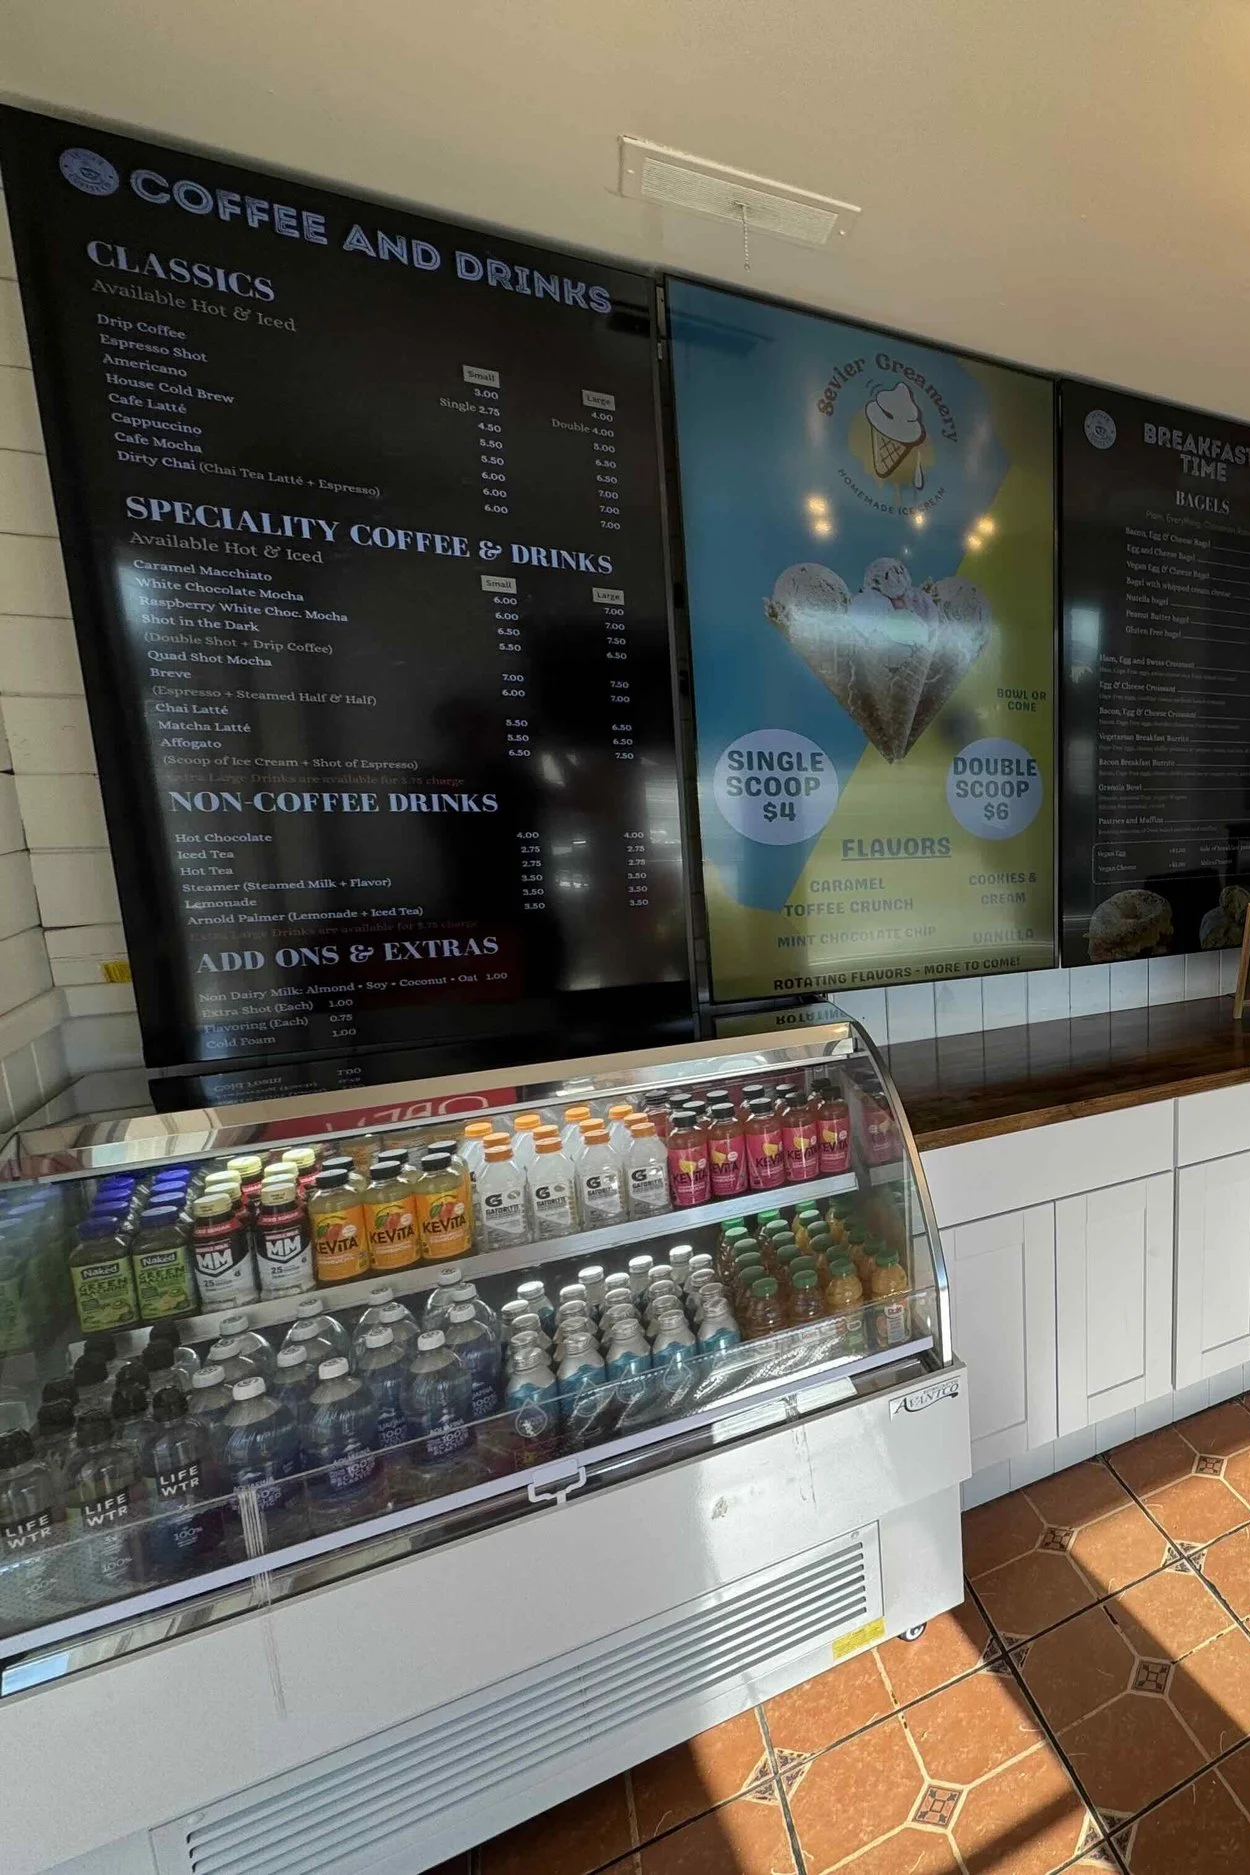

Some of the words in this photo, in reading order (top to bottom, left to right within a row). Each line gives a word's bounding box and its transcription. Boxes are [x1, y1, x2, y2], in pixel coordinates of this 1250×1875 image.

[130, 169, 328, 245] COFFEE
[343, 224, 441, 271] AND
[455, 250, 612, 314] DRINKS
[87, 240, 275, 301] CLASSICS
[92, 280, 186, 309] Available
[190, 298, 226, 320] Hot
[233, 306, 252, 321] &
[257, 312, 296, 332] Iced
[96, 314, 133, 331] Drip
[138, 322, 187, 340] Coffee
[100, 334, 170, 356] Espresso
[174, 347, 208, 362] Shot
[103, 354, 188, 377] Americano
[467, 370, 496, 382] Small
[106, 373, 154, 390] House
[159, 382, 192, 398] Cold
[198, 389, 235, 404] Brew
[474, 388, 498, 400] 3.00
[817, 357, 866, 417] Sevier
[108, 392, 142, 408] Cafe
[148, 398, 187, 414] Latté
[440, 398, 477, 412] Single
[478, 406, 500, 416] 2.75
[112, 412, 202, 434] Cappuccino
[478, 422, 502, 433] 4.50
[552, 418, 590, 433] Double
[592, 427, 614, 438] 4.00
[114, 432, 148, 446] Cafe
[153, 437, 202, 453] Mocha
[118, 450, 158, 467] Dirty
[162, 457, 197, 470] Chai
[200, 461, 236, 478] (Chai
[240, 468, 264, 480] Tea
[268, 471, 303, 486] Latté
[318, 480, 380, 498] Espresso)
[1180, 453, 1228, 482] TIME
[483, 488, 507, 498] 6.00
[838, 468, 894, 515] HOMEMADE
[898, 508, 914, 516] ICE
[1176, 489, 1230, 514] BAGELS
[126, 496, 340, 542] SPECIALITY
[350, 524, 470, 558] COFFEE
[479, 540, 502, 560] &
[511, 544, 613, 574] DRINKS
[600, 520, 620, 530] 7.00
[130, 532, 219, 552] Available
[224, 542, 258, 558] Hot
[264, 545, 280, 558] &
[287, 548, 324, 564] Iced
[134, 559, 196, 574] Caramel
[200, 565, 272, 582] Macchiato
[135, 577, 182, 591] White
[186, 582, 256, 598] Chocolate
[260, 588, 304, 601] Mocha
[486, 580, 512, 590] Small
[596, 592, 620, 602] Large
[140, 596, 215, 612] Raspberry
[219, 602, 262, 614] White
[265, 606, 302, 618] Choc.
[306, 610, 348, 622] Mocha
[142, 614, 175, 626] Shot
[179, 616, 194, 627] in
[197, 618, 220, 629] the
[224, 620, 260, 632] Dark
[148, 650, 186, 662] Quad
[190, 652, 224, 664] Shot
[227, 655, 272, 668] Mocha
[150, 667, 192, 679] Breve
[997, 688, 1028, 700] BOWL
[1031, 690, 1048, 702] OR
[156, 702, 188, 714] Chai
[192, 703, 229, 716] Latté
[1007, 701, 1037, 712] CONE
[158, 720, 212, 732] Matcha
[215, 720, 252, 733] Latté
[160, 737, 222, 750] Affogato
[727, 750, 824, 773] SINGLE
[953, 756, 1038, 777] DOUBLE
[726, 775, 821, 798] SCOOP
[956, 780, 1030, 799] SCOOP
[168, 791, 380, 813] NON-COFFEE
[388, 792, 498, 813] DRINKS
[763, 802, 796, 822] $4
[984, 802, 1010, 822] $6
[175, 834, 202, 843] Hot
[204, 832, 272, 844] Chocolate
[842, 837, 952, 858] FLAVORS
[178, 850, 207, 860] Iced
[210, 849, 234, 860] Tea
[180, 866, 206, 876] Hot
[208, 866, 234, 876] Tea
[968, 872, 1026, 886] COOKIES
[1028, 872, 1038, 883] &
[182, 882, 240, 892] Steamer
[243, 880, 304, 893] (Steamed
[308, 879, 336, 890] Milk
[350, 877, 392, 890] Flavor)
[810, 877, 886, 894] CARAMEL
[185, 898, 258, 910] Lemonade
[784, 902, 844, 918] TOFFEE
[850, 898, 914, 913] CRUNCH
[980, 892, 1026, 906] CREAM
[778, 934, 816, 949] MINT
[820, 929, 902, 946] CHOCOLATE
[904, 926, 937, 939] CHIP
[973, 927, 1035, 944] VANILLA
[197, 951, 264, 973] ADD
[276, 945, 340, 968] ONS
[350, 944, 374, 964] &
[384, 936, 498, 961] EXTRAS
[774, 972, 848, 990] ROTATING
[851, 966, 912, 983] FLAVORS
[924, 962, 961, 976] MORE
[964, 960, 980, 972] TO
[983, 955, 1021, 970] COME!
[200, 992, 226, 1003] Non
[230, 989, 267, 1003] Dairy
[270, 986, 304, 998] Milk:
[306, 982, 355, 995] Almond
[366, 980, 388, 992] Soy
[399, 976, 447, 988] Coconut
[458, 974, 478, 982] Oat
[485, 972, 508, 982] 1.00
[485, 1194, 502, 1207] G
[142, 1254, 176, 1265] Naked
[83, 1265, 118, 1278] Naked
[160, 1466, 198, 1486] LIFE
[161, 1478, 200, 1496] WTR
[85, 1493, 128, 1516] LIFE
[5, 1514, 50, 1538] LIFE
[87, 1506, 128, 1527] WTR
[8, 1526, 51, 1549] WTR
